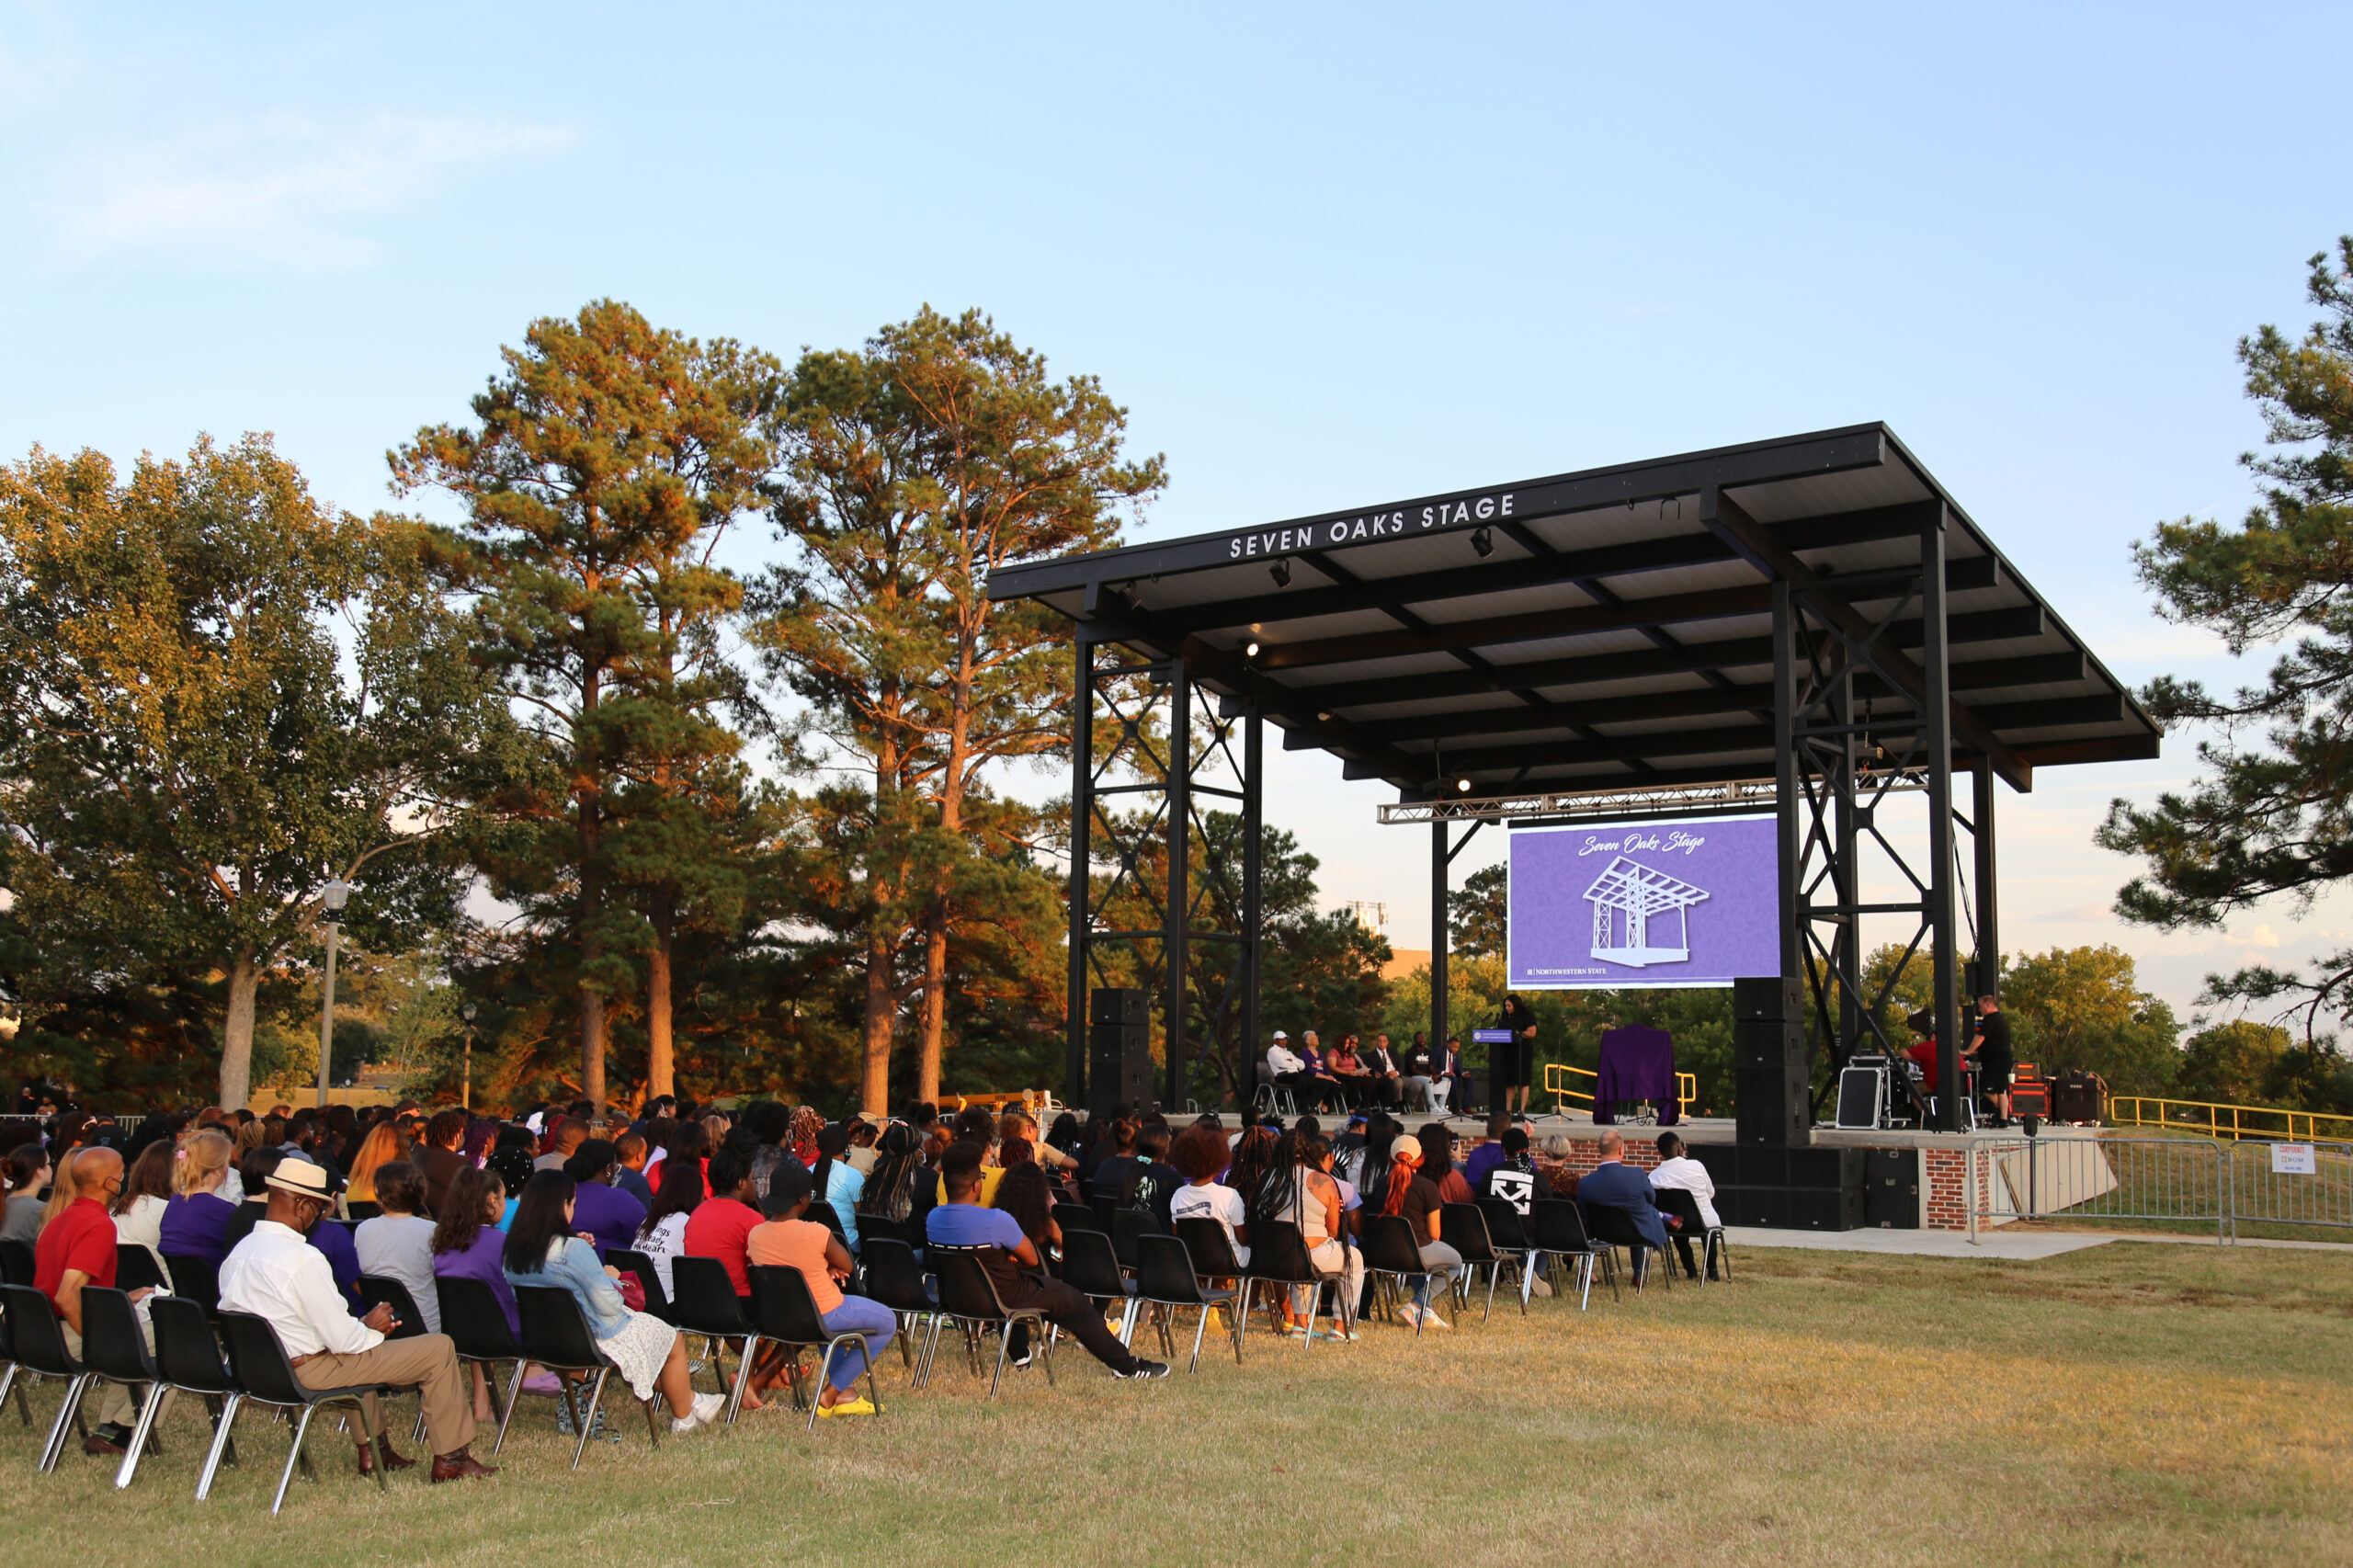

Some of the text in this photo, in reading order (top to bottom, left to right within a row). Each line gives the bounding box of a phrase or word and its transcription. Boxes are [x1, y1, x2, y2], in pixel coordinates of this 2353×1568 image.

[1230, 494, 1515, 559] SEVEN OAKS STAGE
[1578, 831, 1705, 857] Seven Oaks Stage
[1587, 967, 1607, 975] STATE
